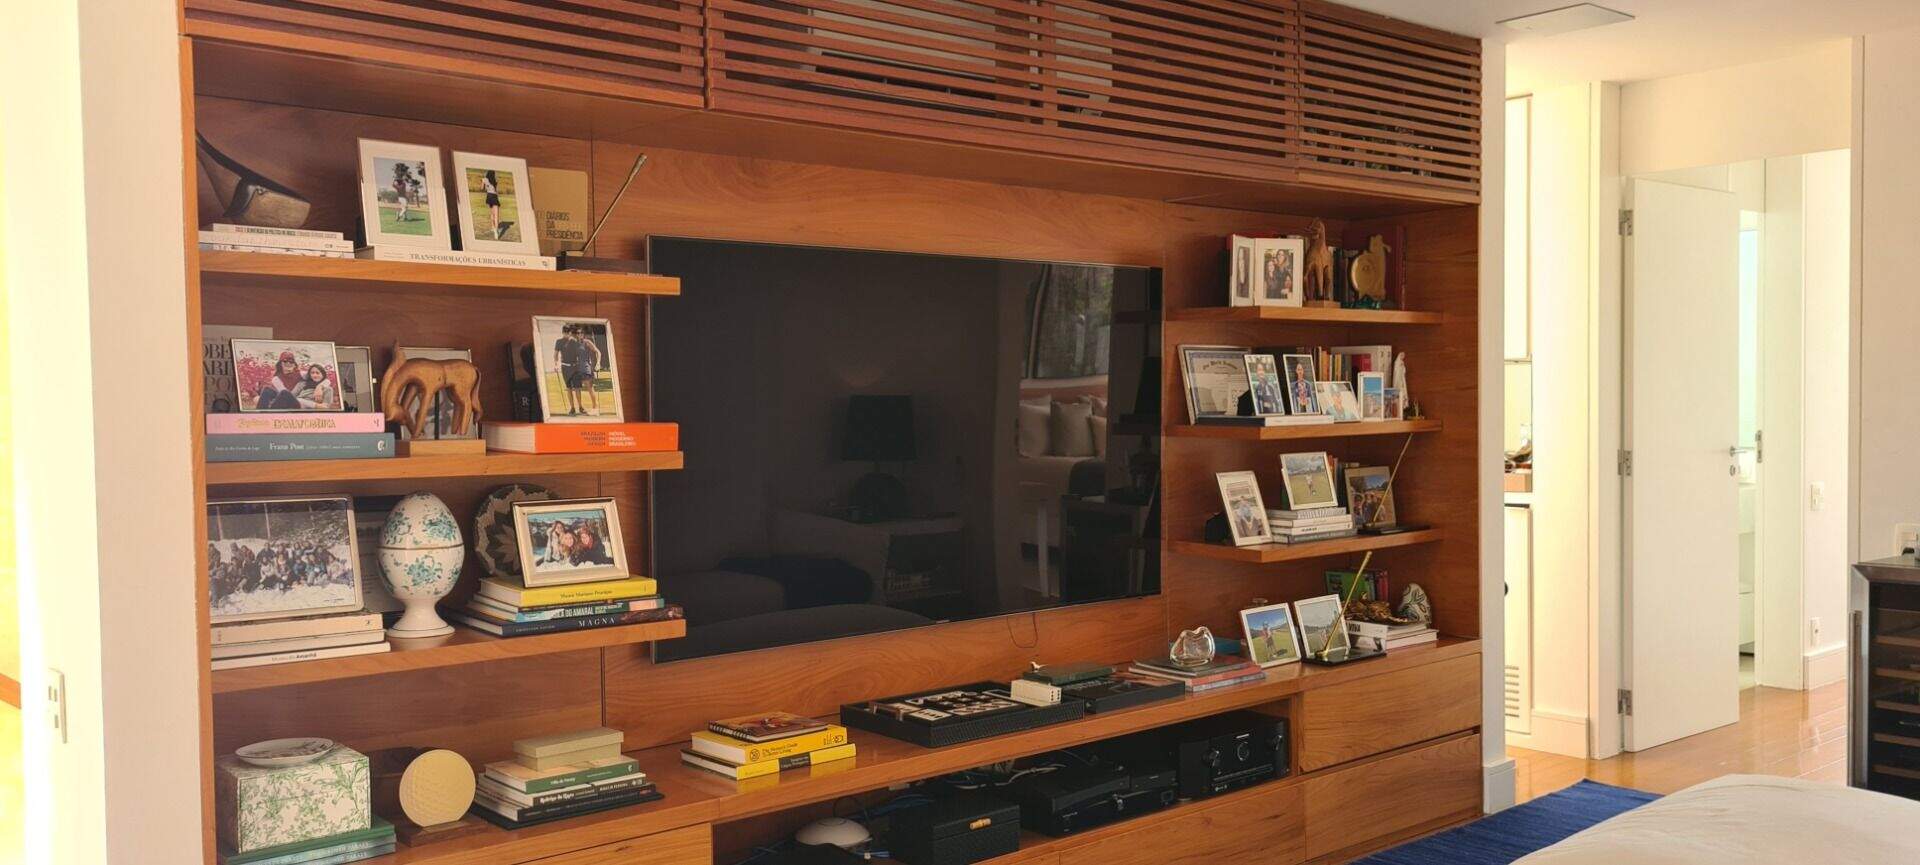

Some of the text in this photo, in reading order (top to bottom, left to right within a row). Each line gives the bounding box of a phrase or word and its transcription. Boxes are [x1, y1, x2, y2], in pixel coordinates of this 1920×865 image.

[410, 253, 478, 264] TRANSFORMAÇÕES
[478, 257, 527, 266] URBANÍSTICAS
[578, 617, 616, 628] MAGNA
